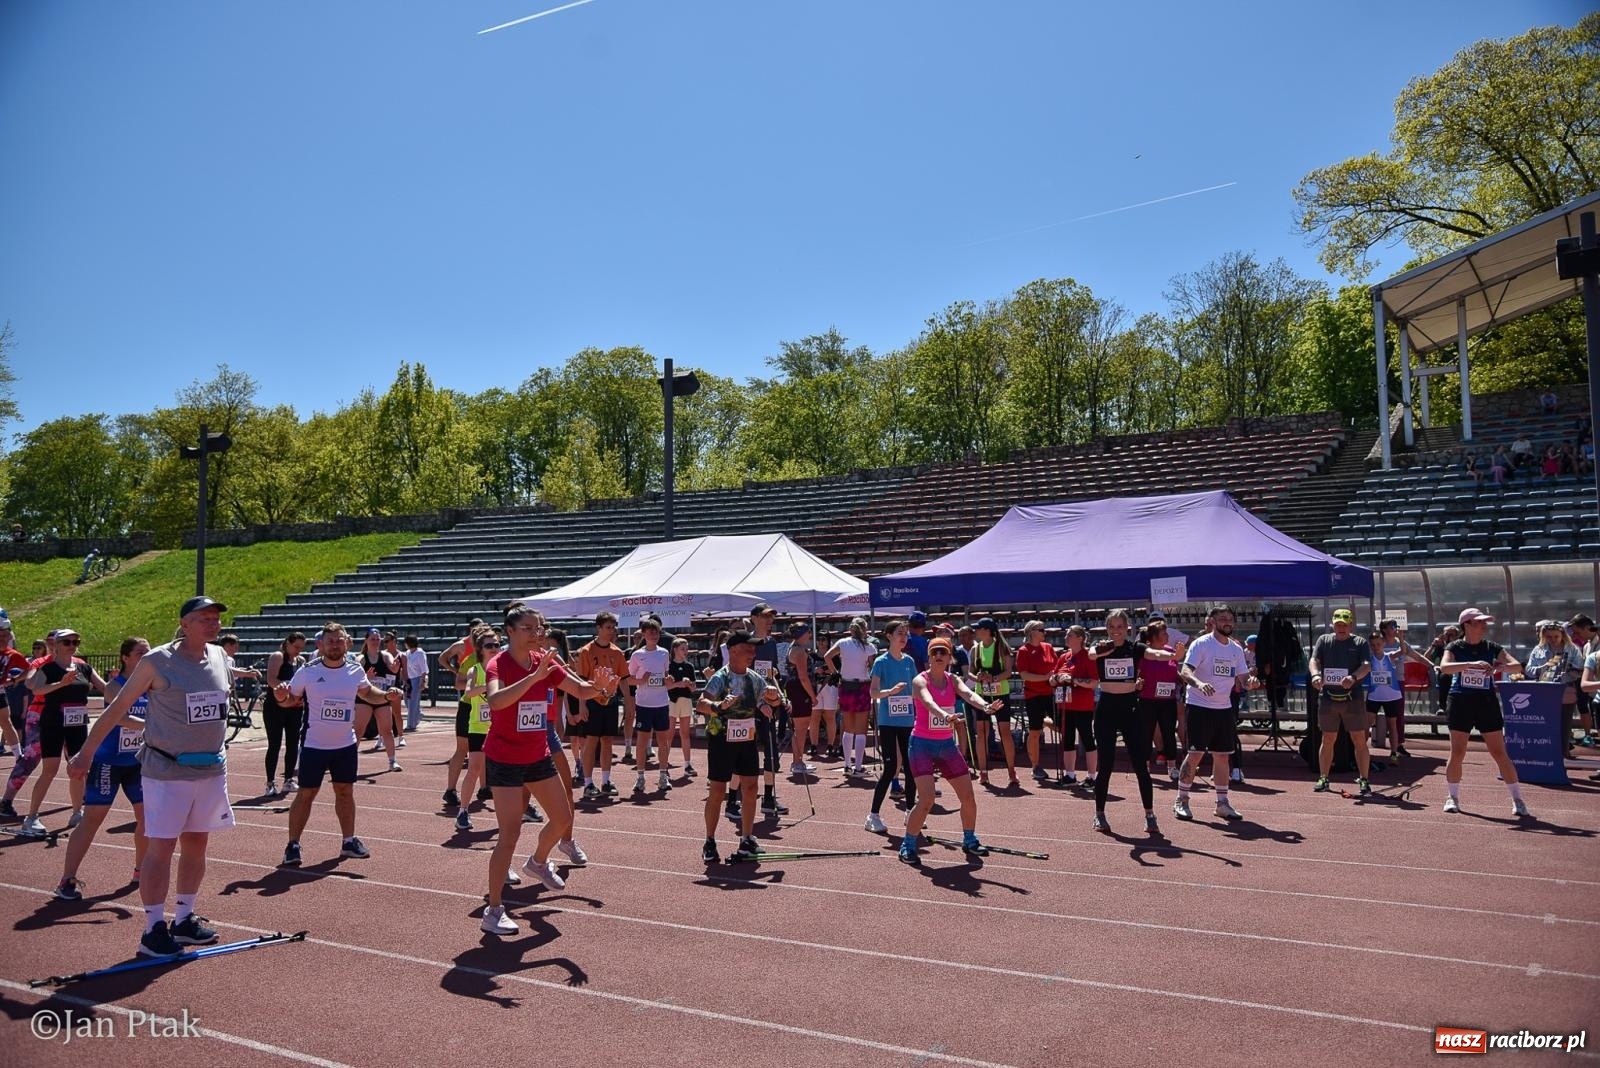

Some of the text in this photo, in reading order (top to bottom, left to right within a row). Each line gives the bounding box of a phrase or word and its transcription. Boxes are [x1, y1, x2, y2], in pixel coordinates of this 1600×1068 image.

[1108, 667, 1126, 676] 032
[1215, 665, 1230, 674] 036
[1464, 676, 1483, 686] 050
[193, 704, 217, 718] 257
[324, 708, 344, 719] 039
[891, 704, 908, 713] 056
[68, 714, 82, 723] 251
[521, 713, 541, 726] 042
[731, 728, 748, 738] 100
